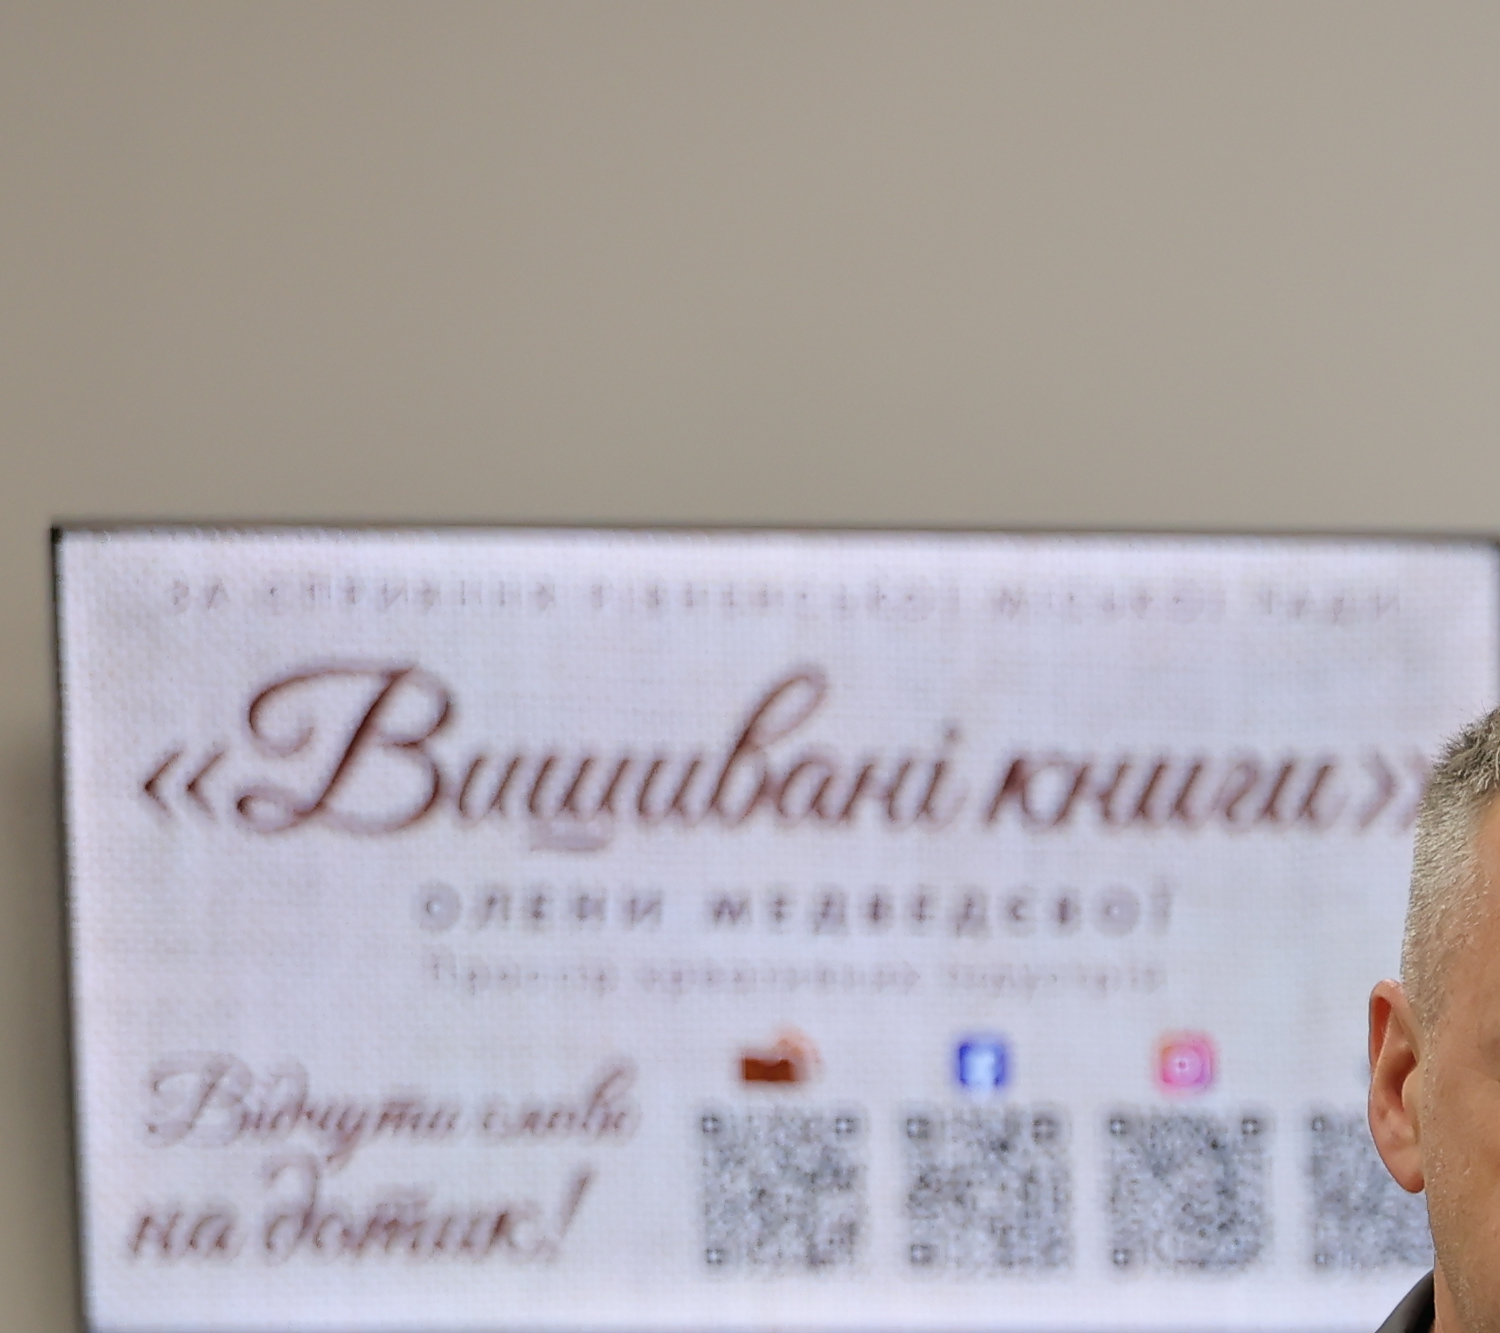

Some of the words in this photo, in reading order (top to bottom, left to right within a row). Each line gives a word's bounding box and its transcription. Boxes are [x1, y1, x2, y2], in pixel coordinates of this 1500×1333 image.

[142, 656, 968, 853] «Вишивані
[418, 880, 666, 936] ОЛЕНИ
[706, 874, 1174, 942] МЕДВЕДЄВОЇ
[126, 1198, 242, 1265] на
